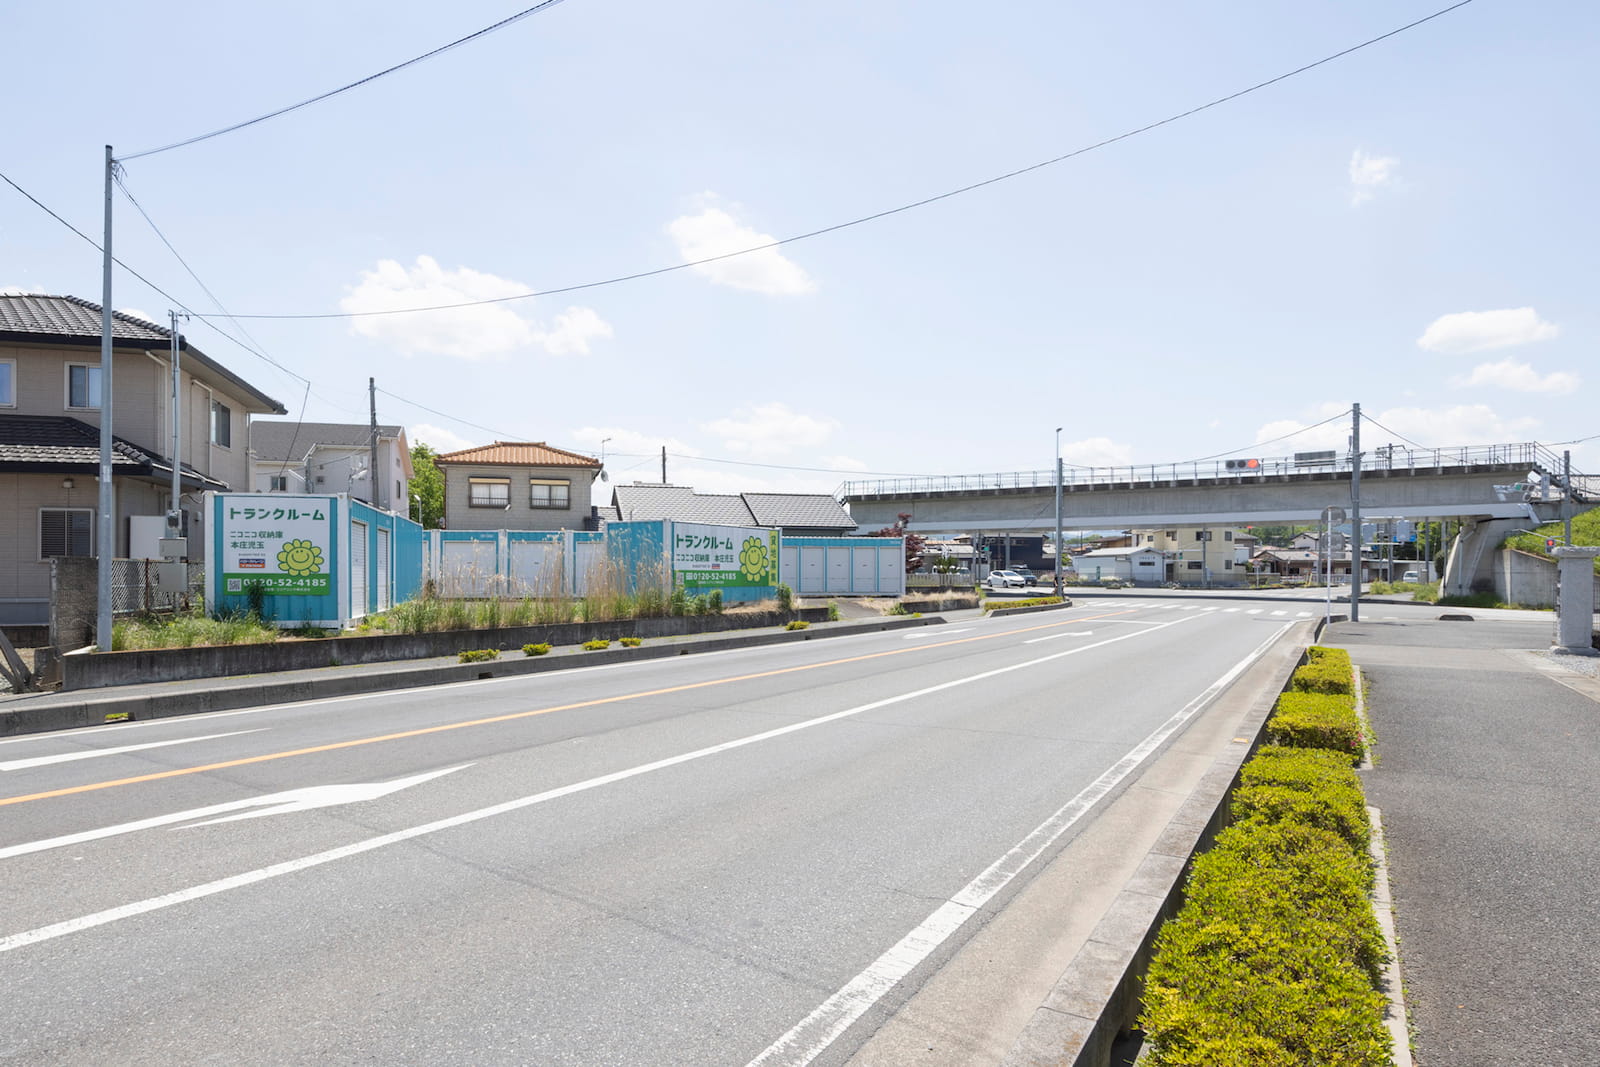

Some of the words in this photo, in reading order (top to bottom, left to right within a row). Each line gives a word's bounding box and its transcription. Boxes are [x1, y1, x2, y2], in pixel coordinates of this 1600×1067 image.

[230, 508, 325, 520] トランクルーム
[676, 534, 733, 550] トランクルーム
